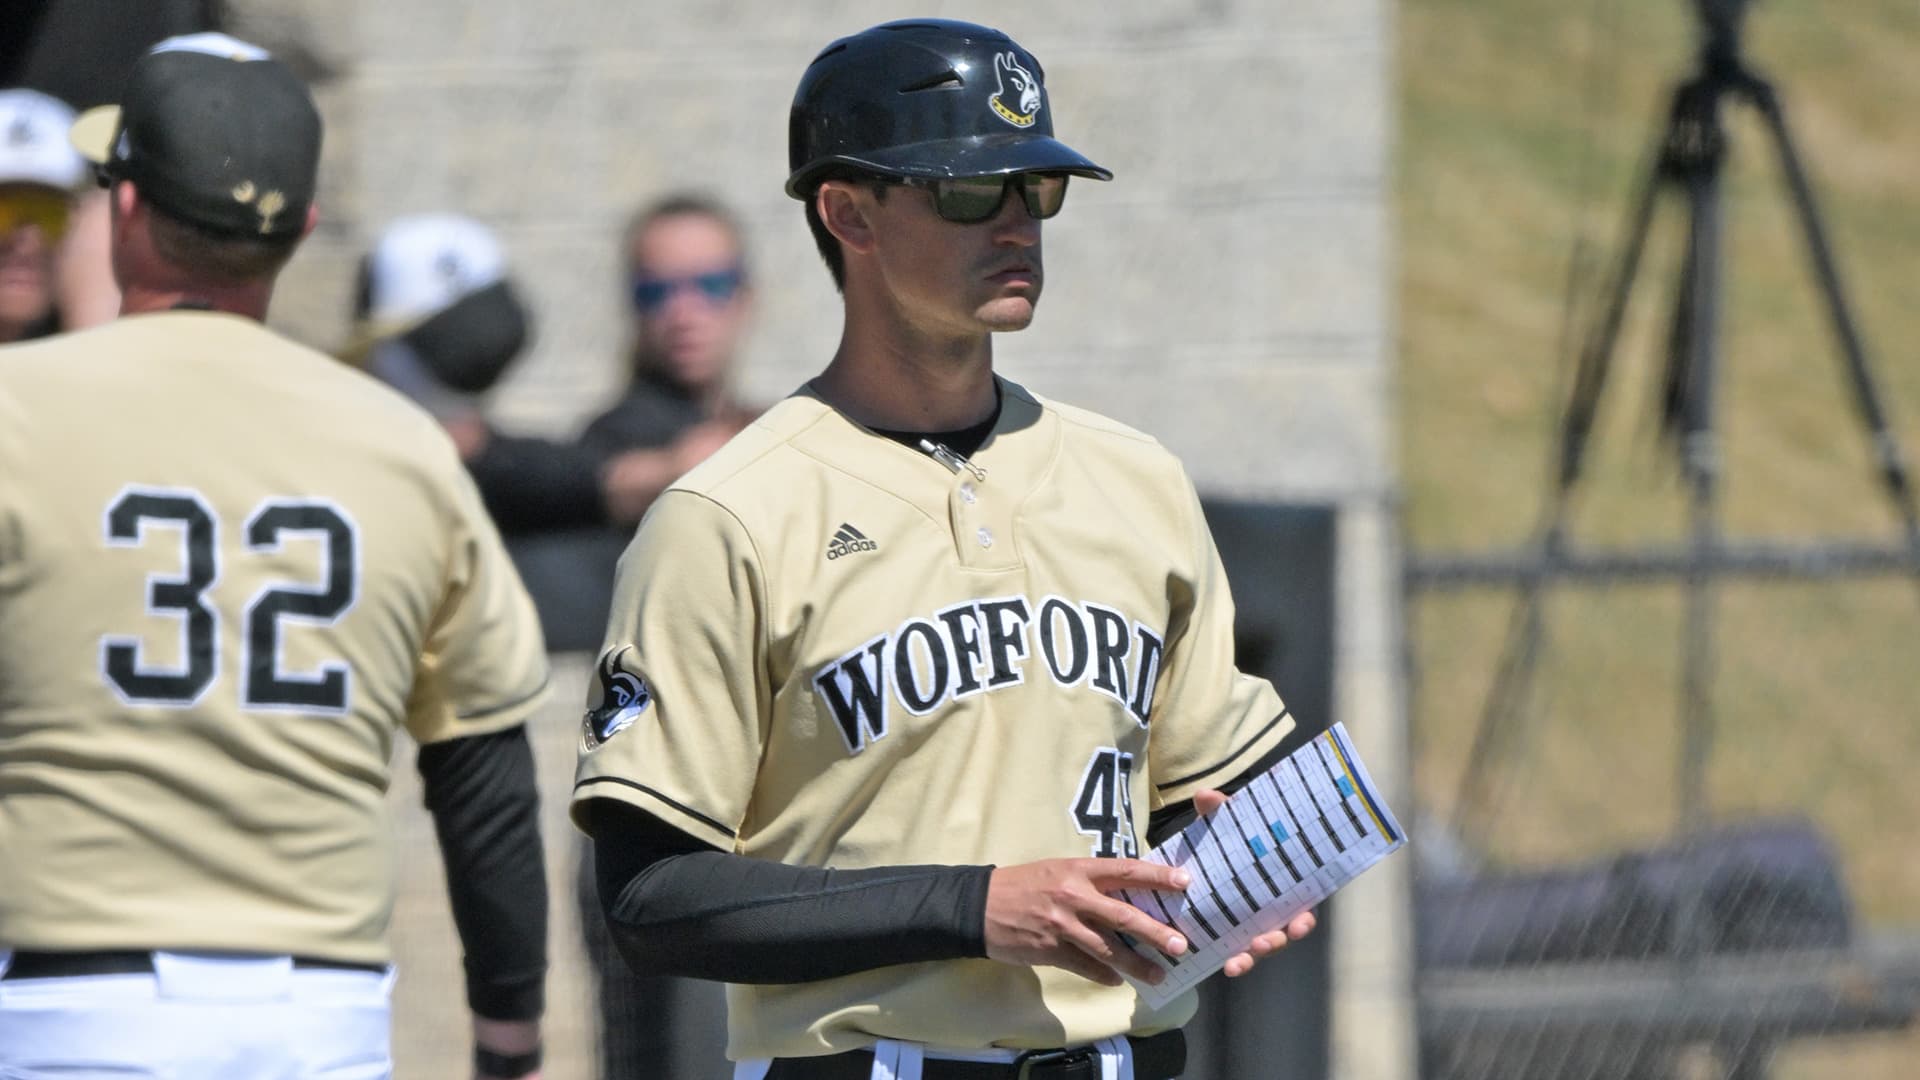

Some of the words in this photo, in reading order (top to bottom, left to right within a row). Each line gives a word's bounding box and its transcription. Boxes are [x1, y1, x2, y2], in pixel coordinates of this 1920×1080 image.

[98, 484, 361, 716] 32
[827, 540, 878, 560] adidas
[812, 594, 1163, 755] WOFFORD
